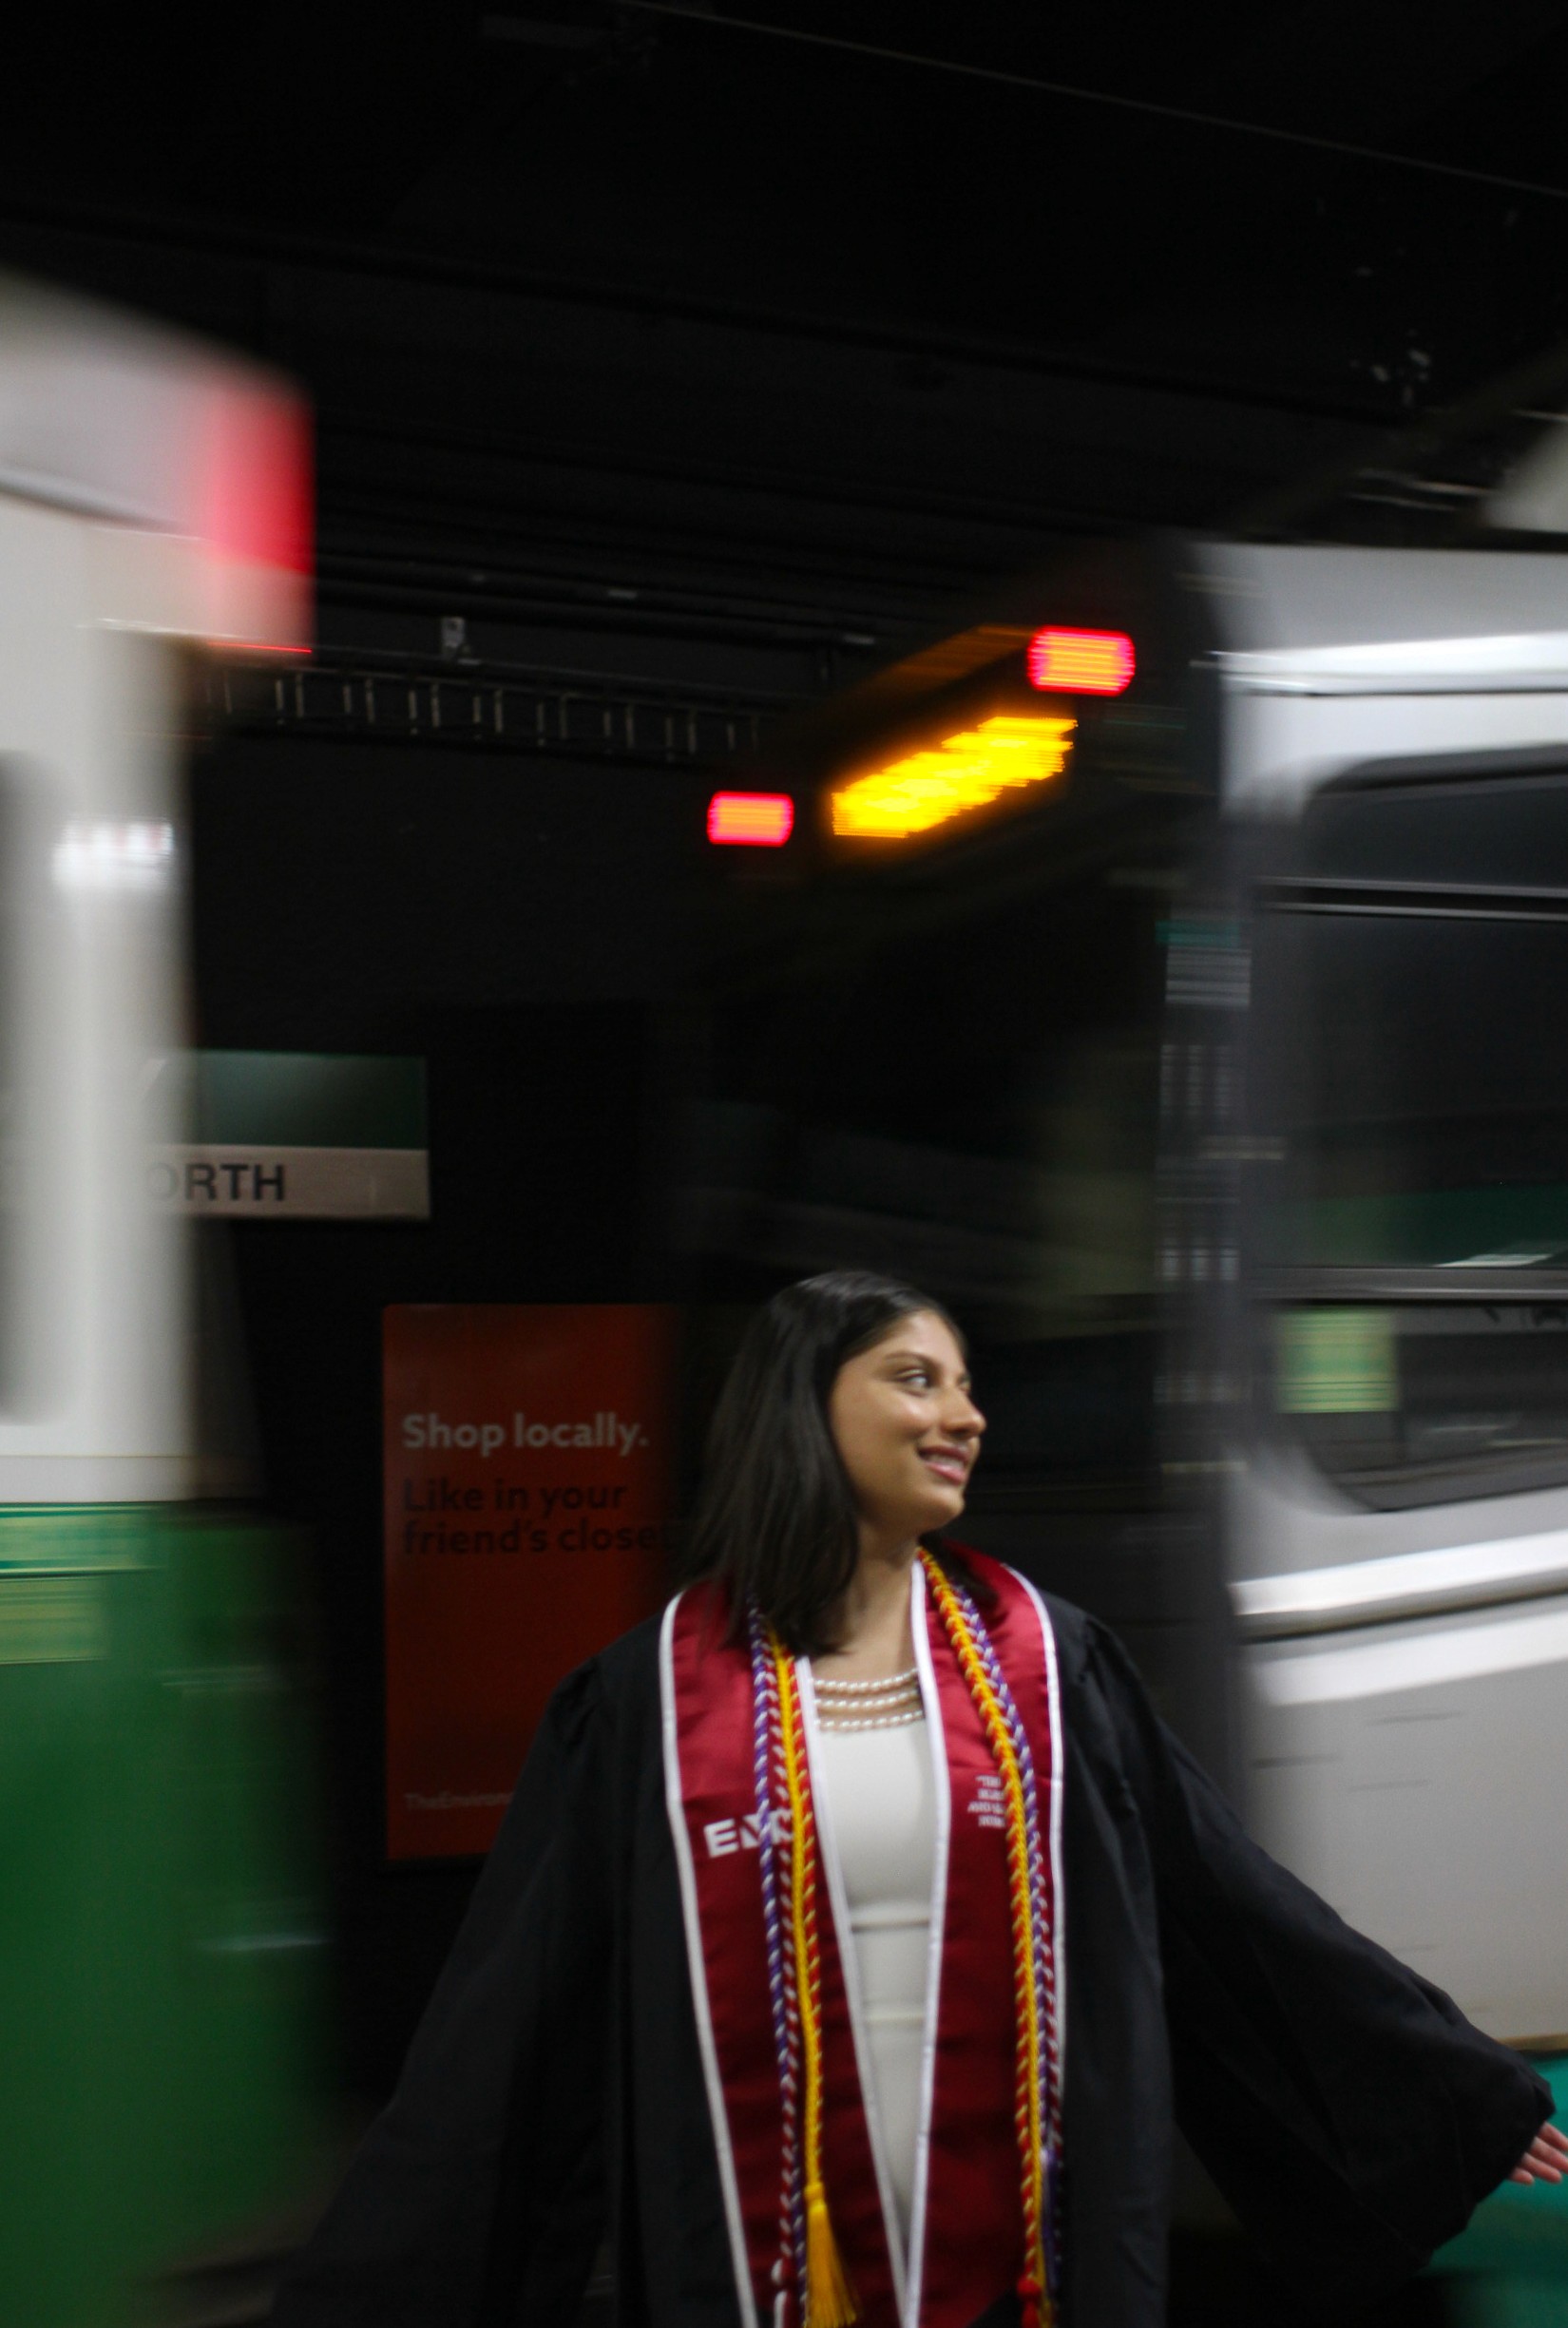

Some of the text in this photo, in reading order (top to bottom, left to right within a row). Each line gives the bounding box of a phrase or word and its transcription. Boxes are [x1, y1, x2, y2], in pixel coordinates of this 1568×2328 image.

[401, 1411, 651, 1458] Shop locally.
[403, 1476, 628, 1519] Like in your
[404, 1517, 548, 1554] friend's
